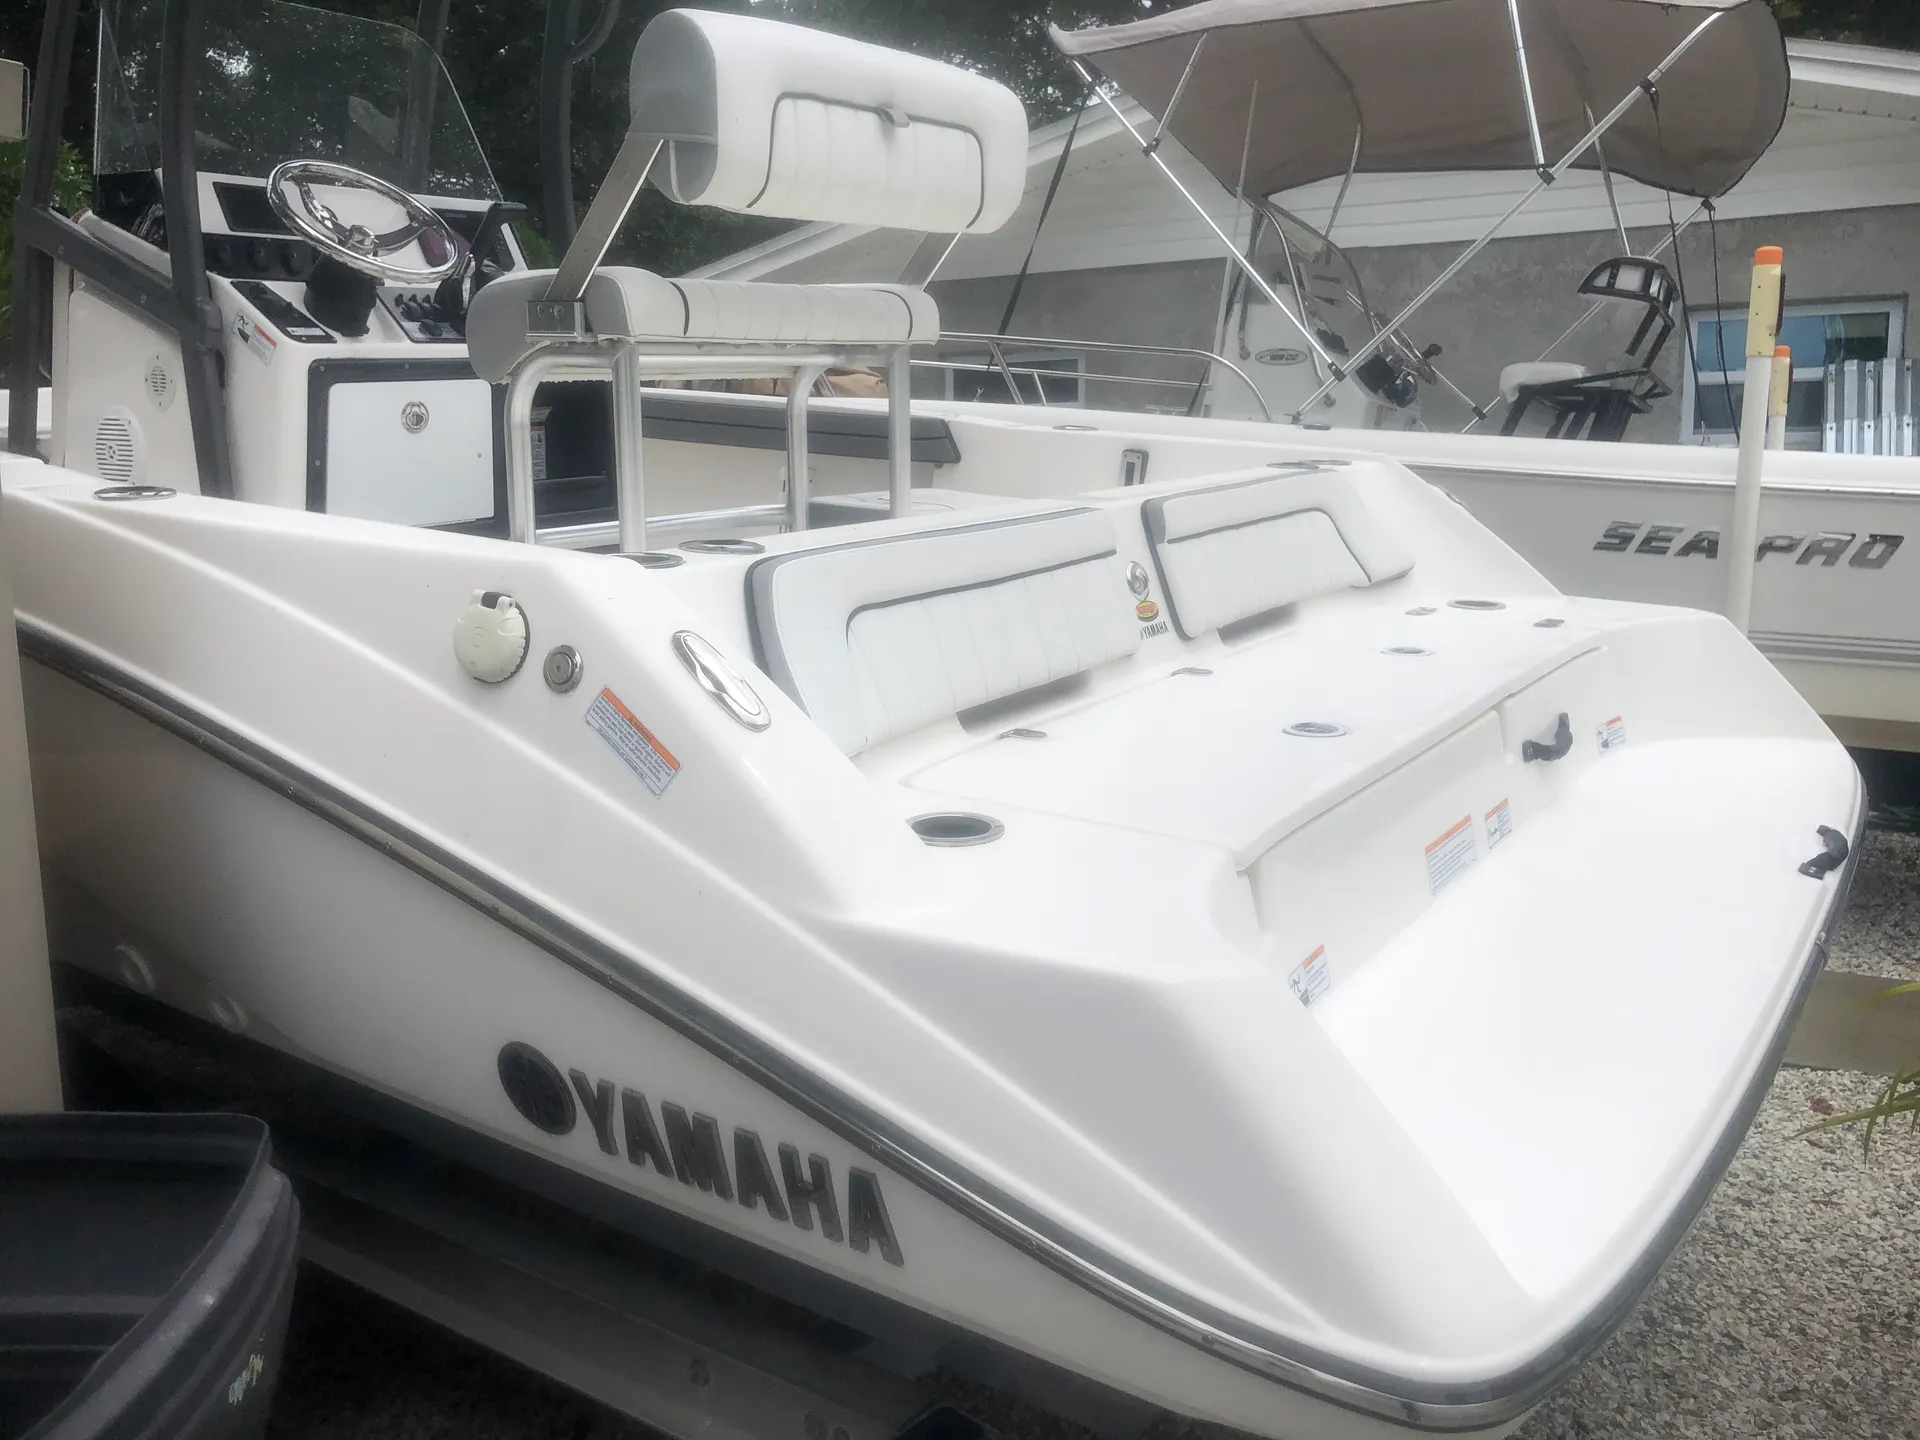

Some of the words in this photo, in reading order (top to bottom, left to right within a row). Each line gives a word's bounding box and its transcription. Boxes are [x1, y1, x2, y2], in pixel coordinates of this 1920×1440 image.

[1593, 520, 1721, 560] SEA
[1754, 531, 1905, 570] PRO
[1142, 620, 1169, 639] YAMAHA
[568, 1067, 905, 1268] YAMAHA
